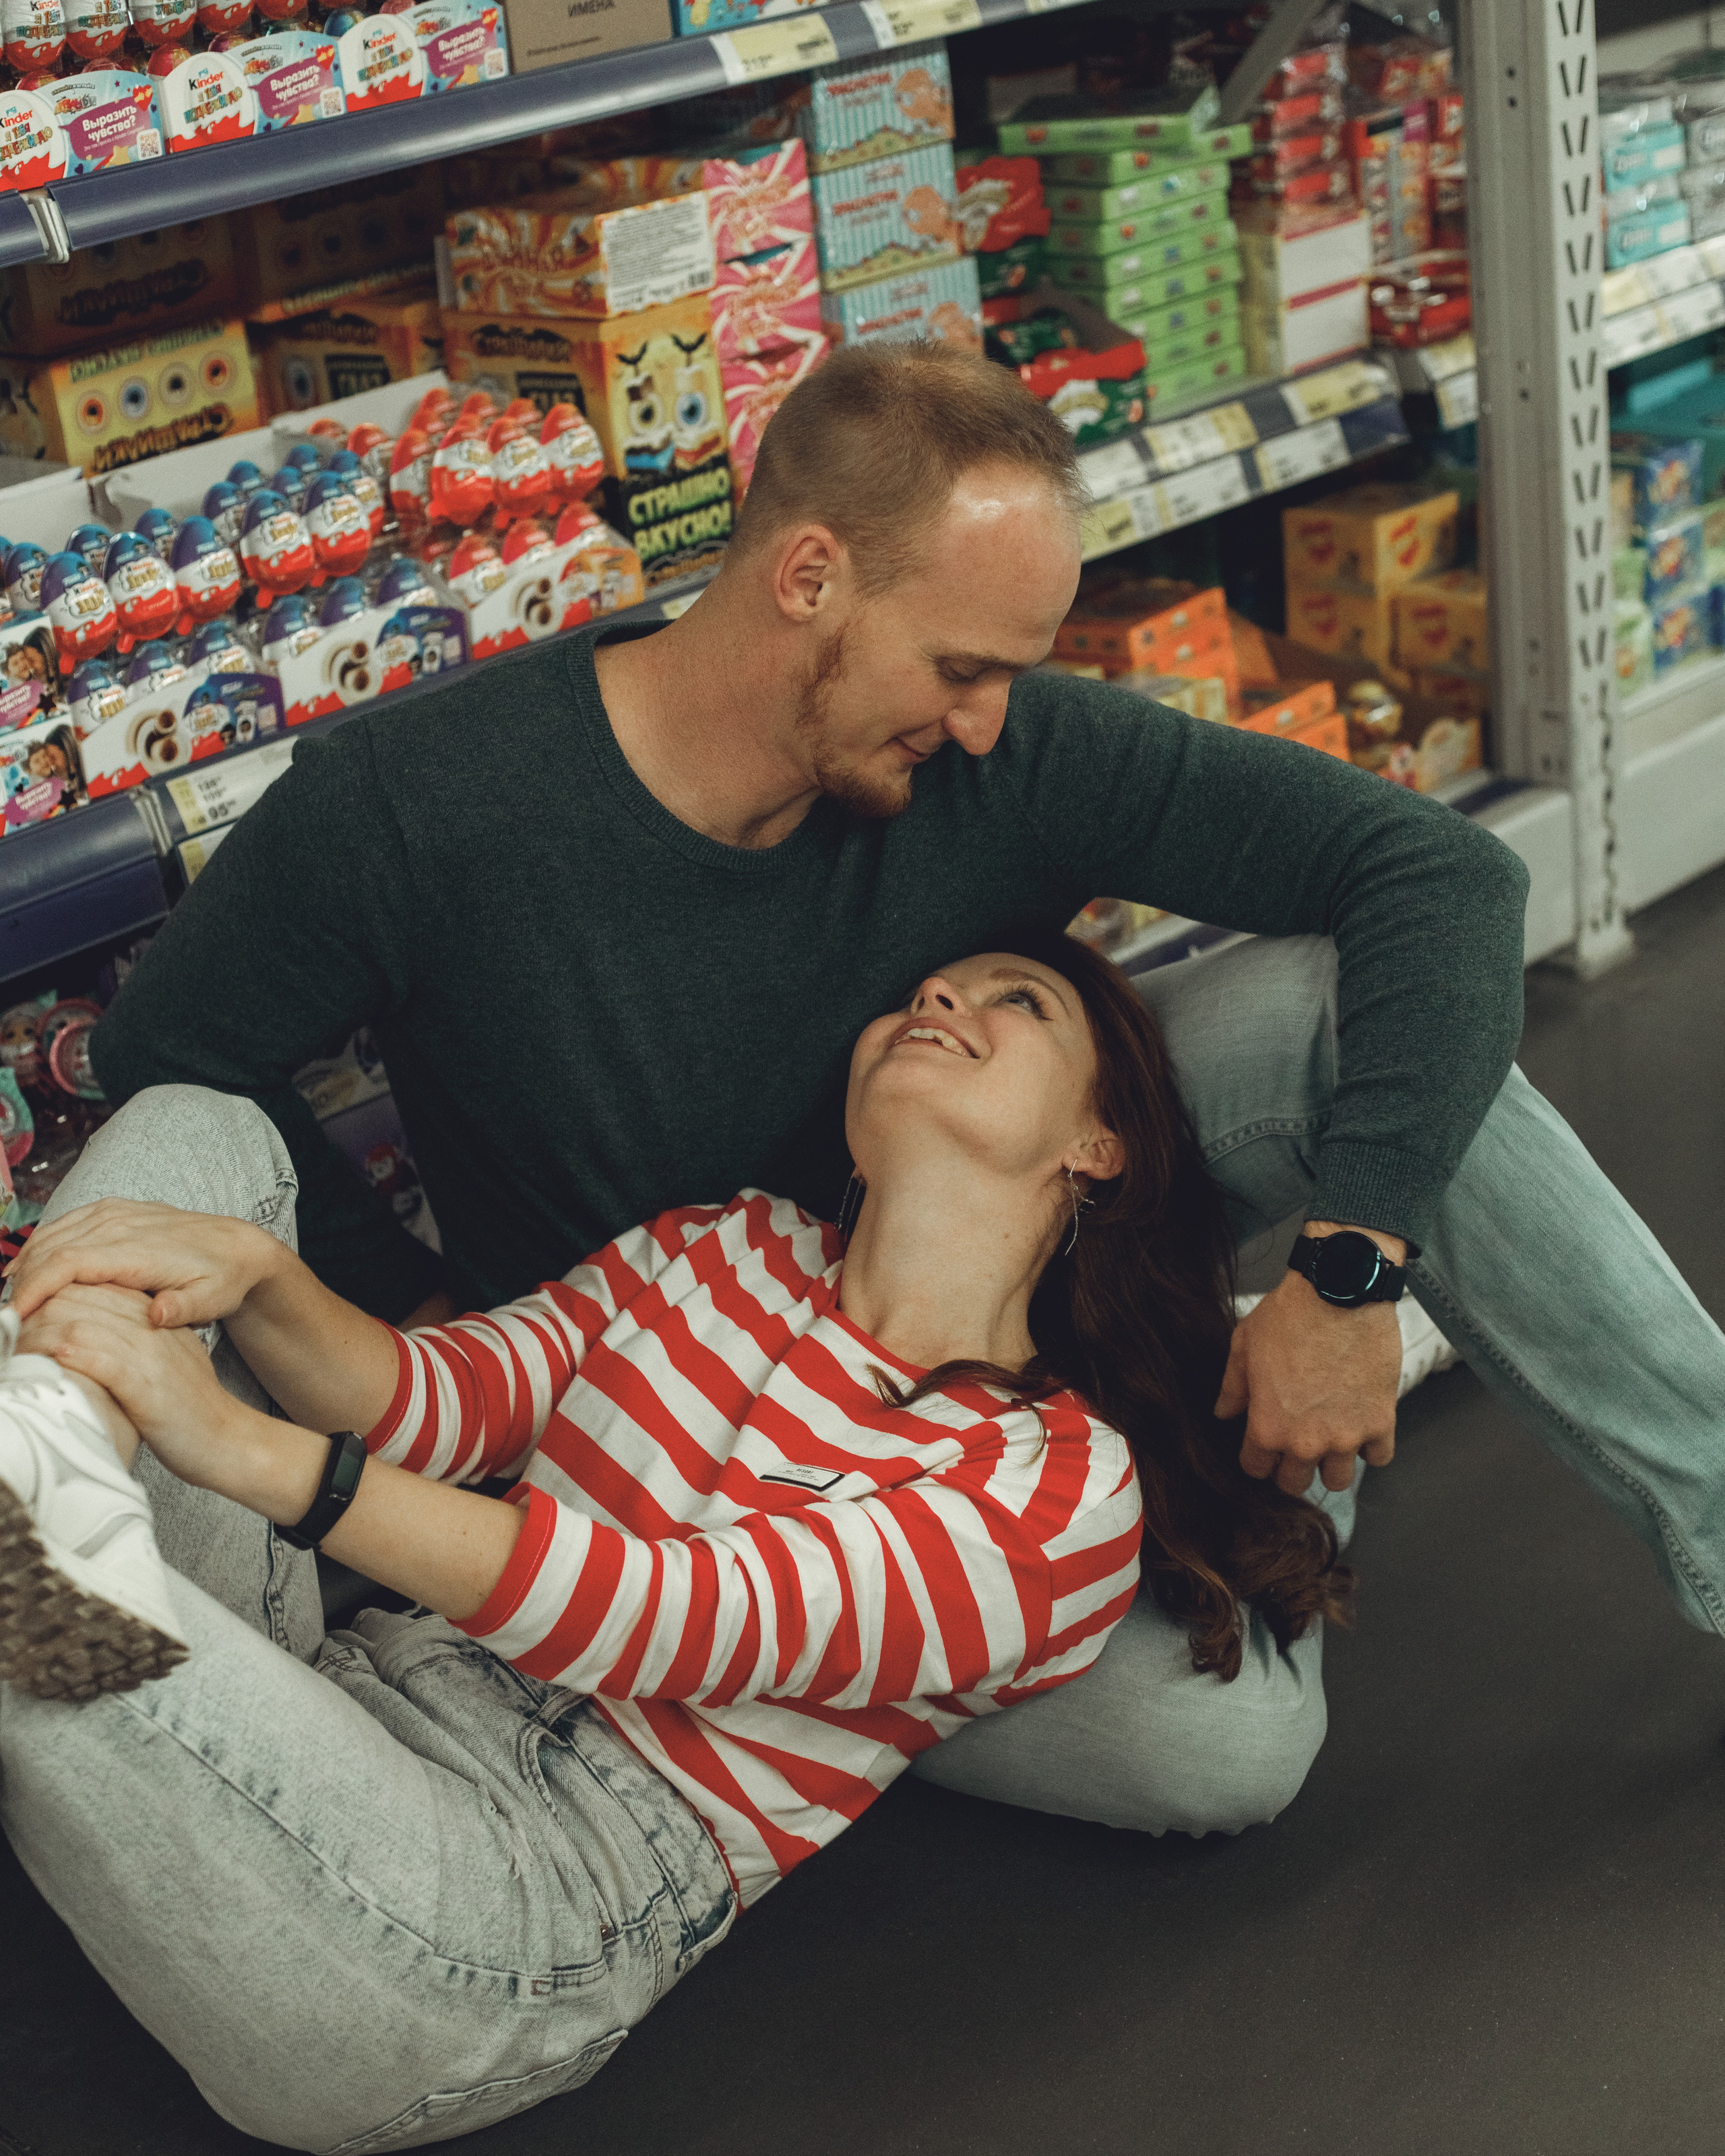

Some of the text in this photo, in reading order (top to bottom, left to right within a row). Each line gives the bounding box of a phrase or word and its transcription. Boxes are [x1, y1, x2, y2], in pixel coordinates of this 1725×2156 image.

[189, 71, 223, 90] Kinder
[270, 64, 321, 91] Выразить
[276, 73, 320, 102] чувства?
[82, 105, 137, 131] Выразить
[88, 115, 136, 142] чувства?
